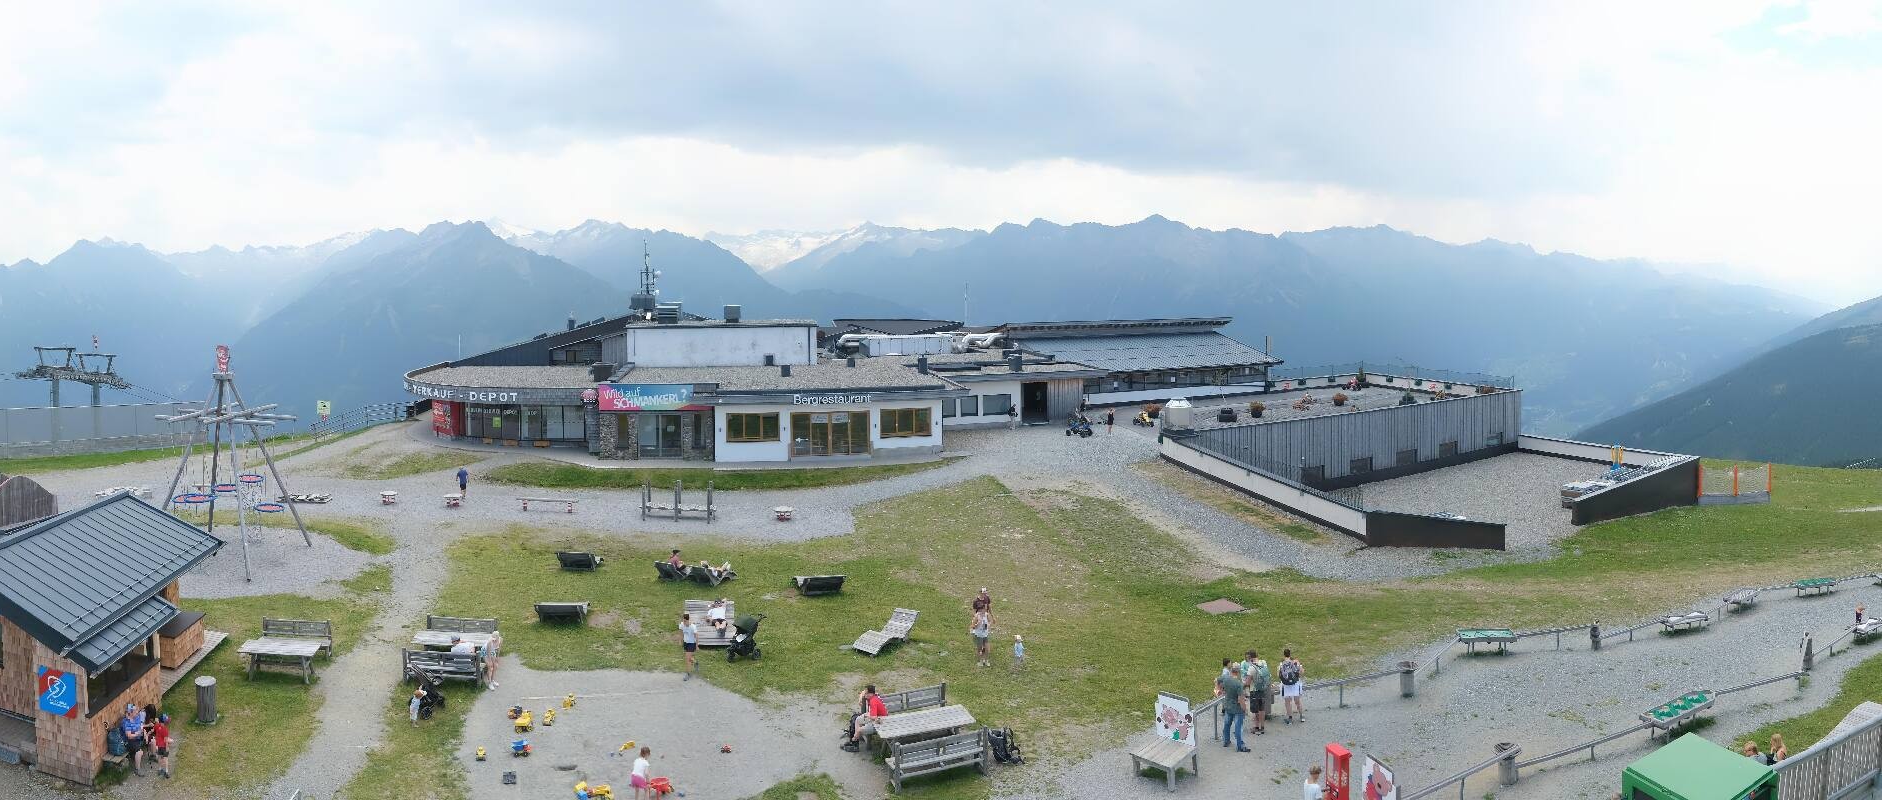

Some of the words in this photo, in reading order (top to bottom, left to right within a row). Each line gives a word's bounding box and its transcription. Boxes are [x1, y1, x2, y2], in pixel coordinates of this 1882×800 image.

[412, 384, 454, 398] VERKAUF
[469, 391, 518, 402] DEPOT
[603, 388, 624, 400] Wild
[625, 386, 641, 398] auf
[613, 388, 687, 409] SCHMANKERL?
[793, 394, 872, 406] Bergrestaurant
